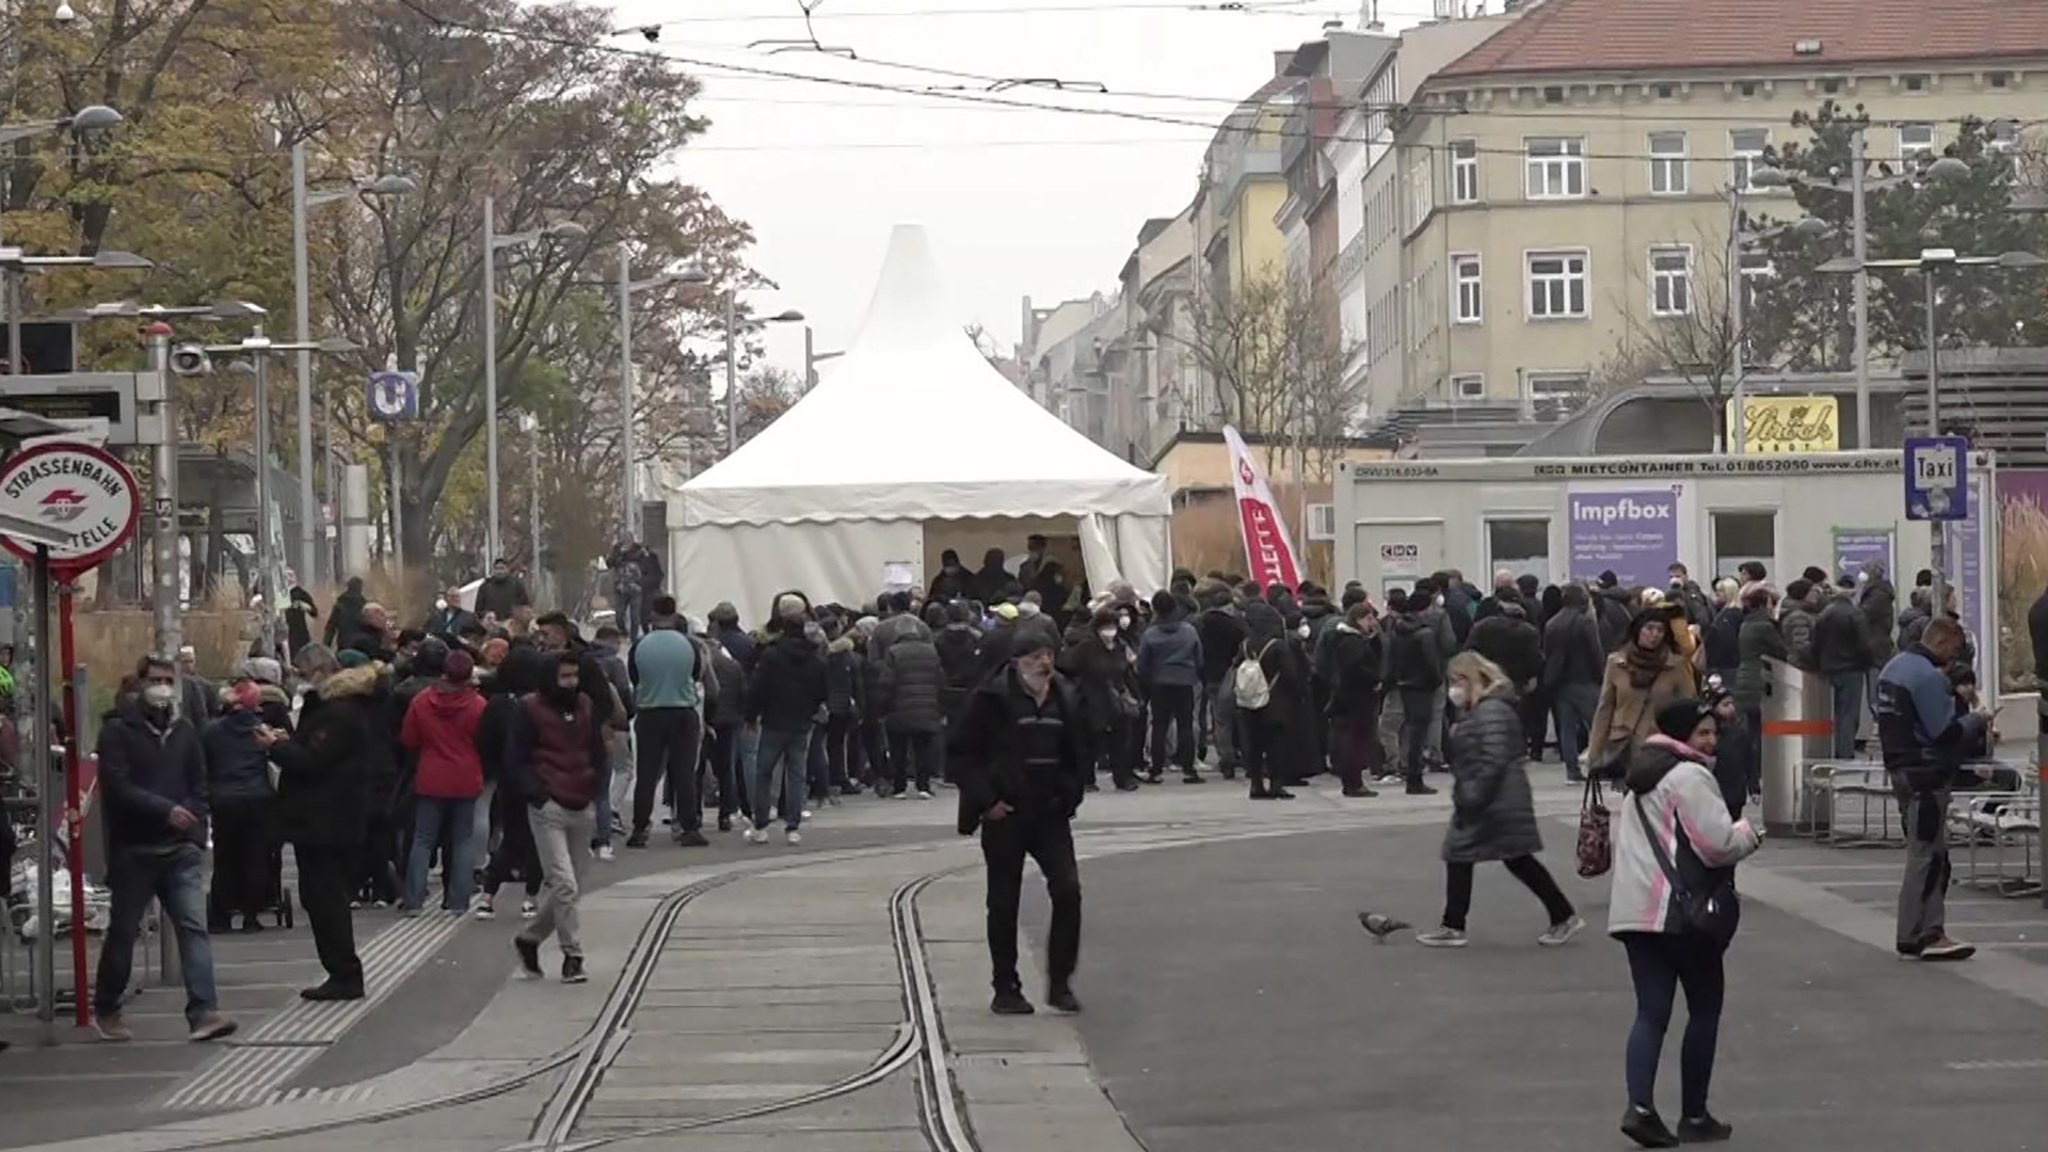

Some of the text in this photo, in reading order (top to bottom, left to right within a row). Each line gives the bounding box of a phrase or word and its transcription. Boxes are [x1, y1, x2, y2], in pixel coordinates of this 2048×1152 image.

[375, 380, 406, 414] U
[4, 457, 122, 499] STRASSENBAHN
[1571, 461, 1694, 475] MIETCONTAINER
[1700, 461, 1723, 471] Tel.
[1917, 457, 1953, 477] Taxi
[1574, 499, 1669, 526] Impfbox
